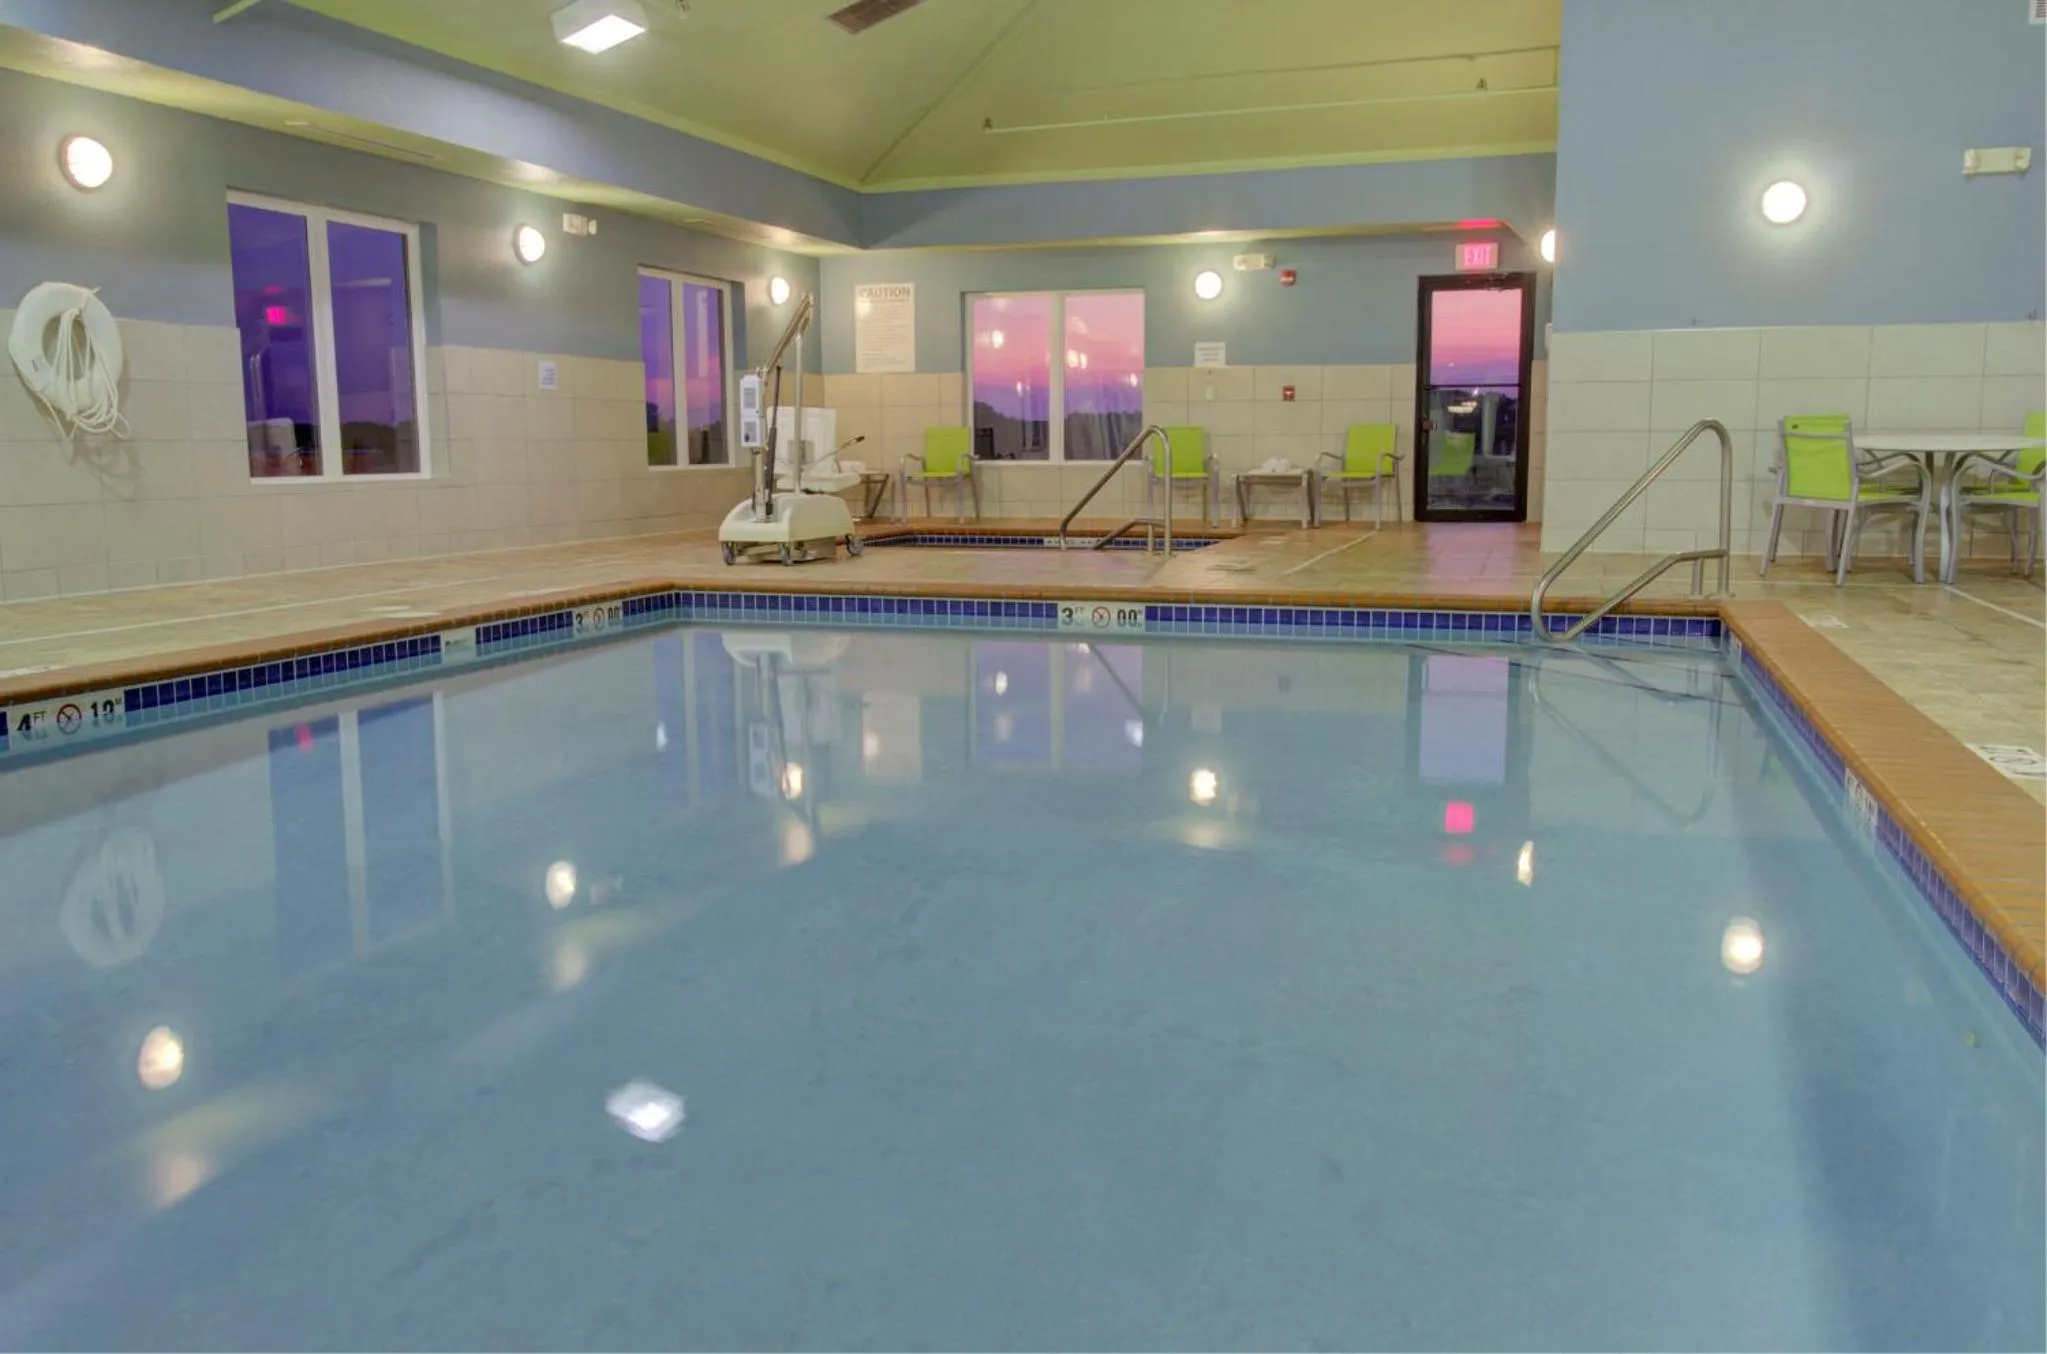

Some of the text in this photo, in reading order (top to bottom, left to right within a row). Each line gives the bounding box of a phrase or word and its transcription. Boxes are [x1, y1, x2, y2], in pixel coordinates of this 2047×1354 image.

[1463, 245, 1493, 267] EXIT
[859, 287, 910, 299] CAUTION
[1061, 607, 1074, 625] 3
